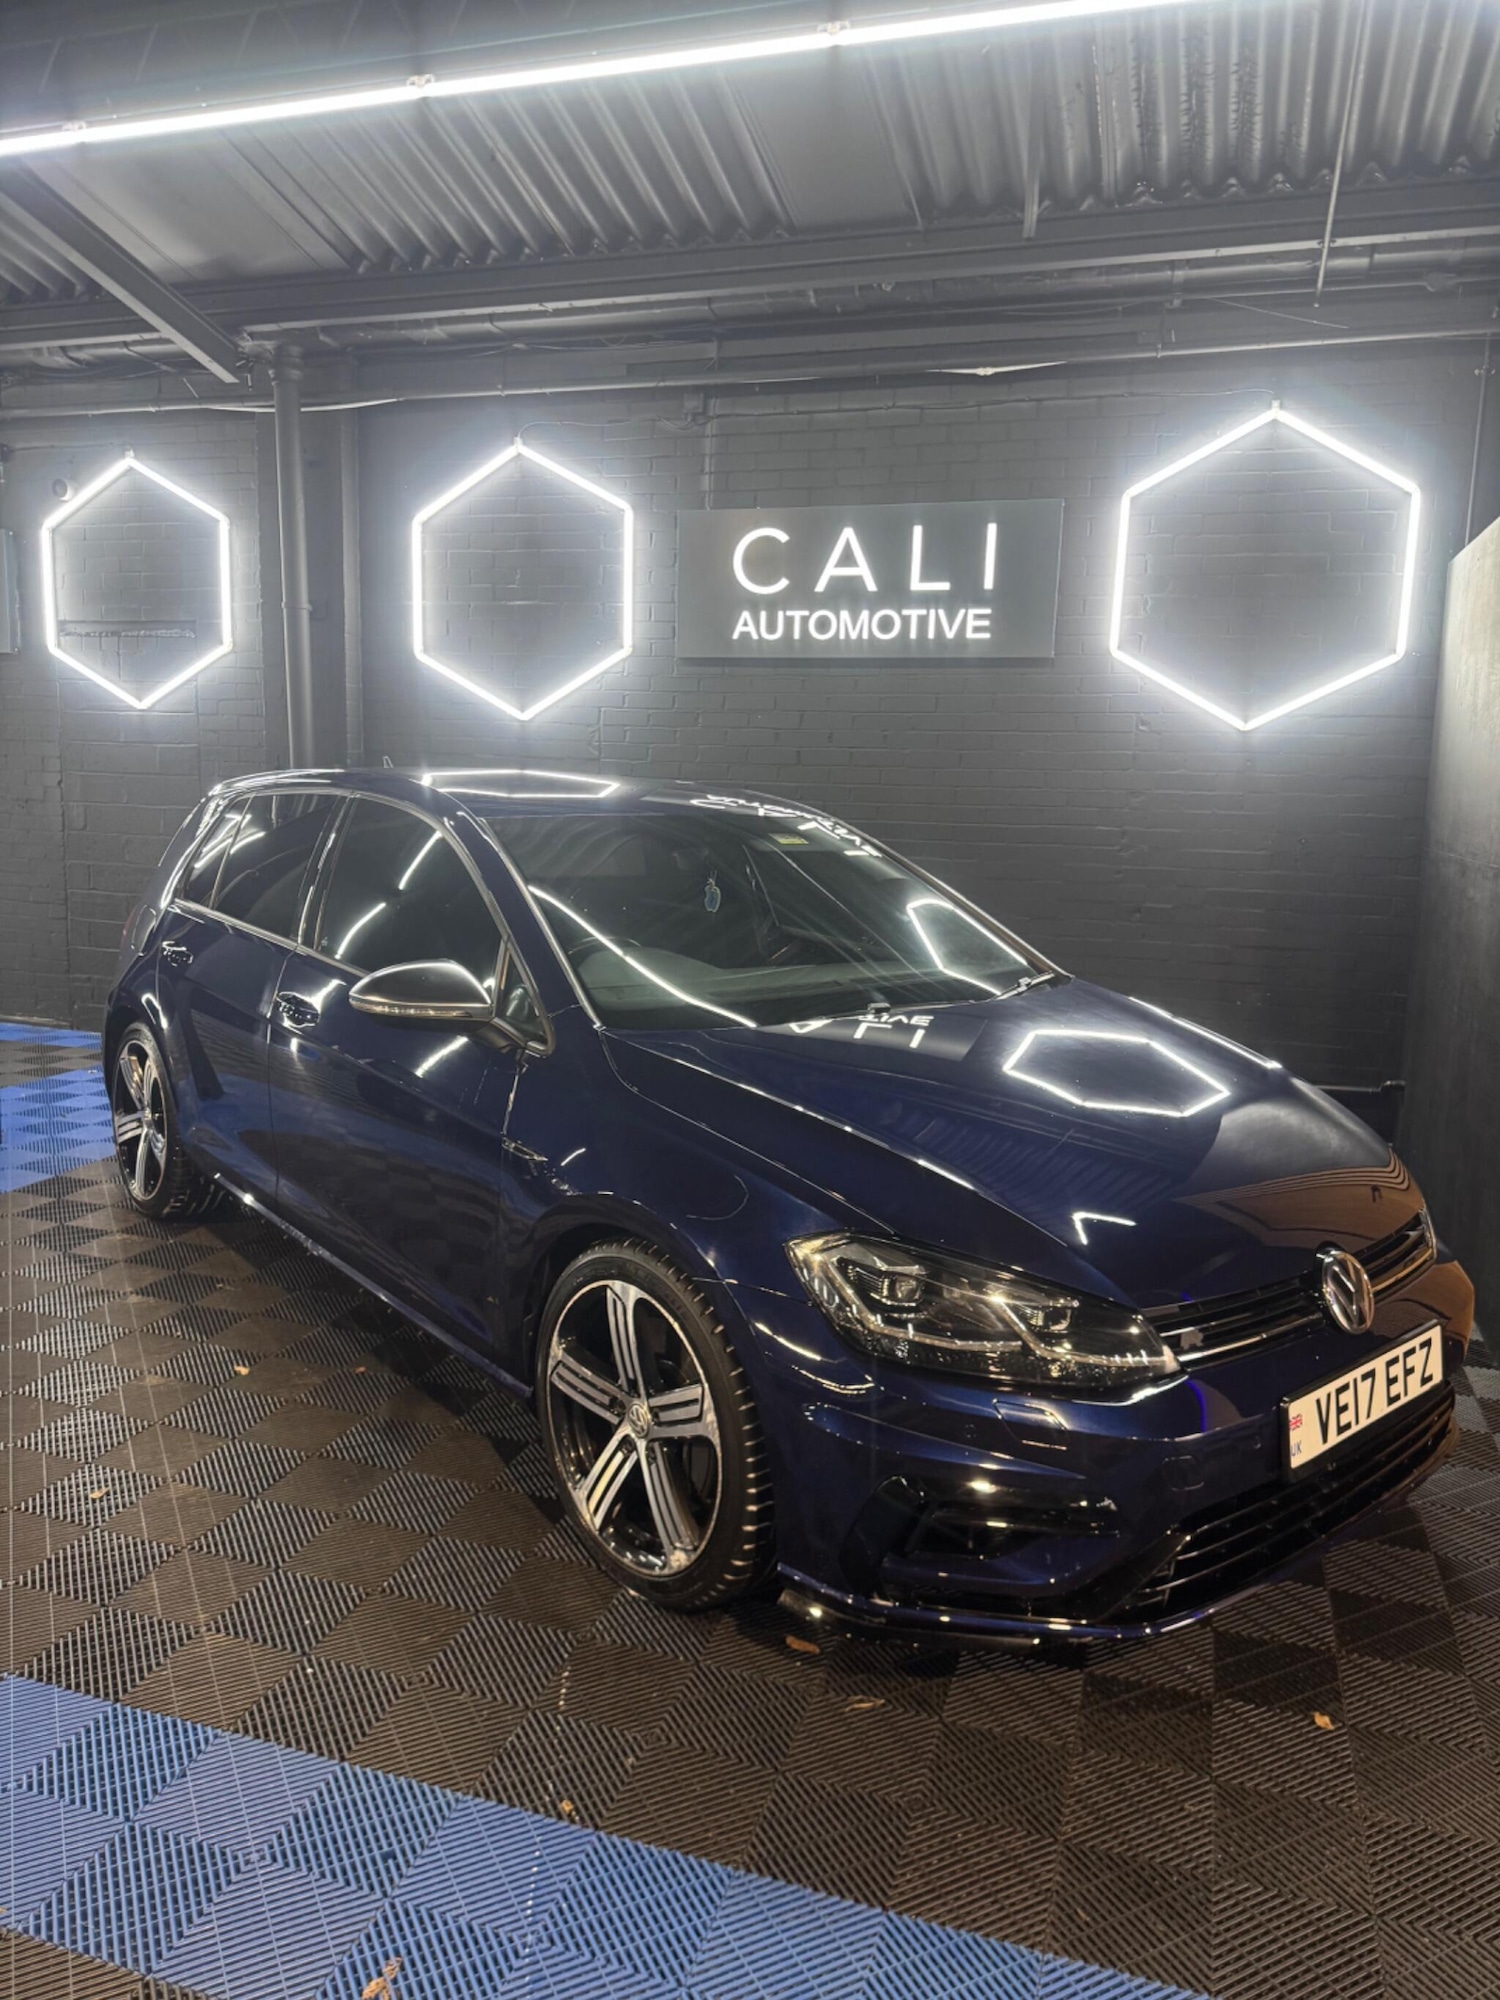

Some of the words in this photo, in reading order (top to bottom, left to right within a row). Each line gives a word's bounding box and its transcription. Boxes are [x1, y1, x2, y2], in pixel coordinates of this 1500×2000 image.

[732, 522, 998, 595] CALI
[732, 608, 993, 641] AUTOMOTIVE
[1385, 1337, 1433, 1408] EFZ
[1290, 1440, 1302, 1457] UK
